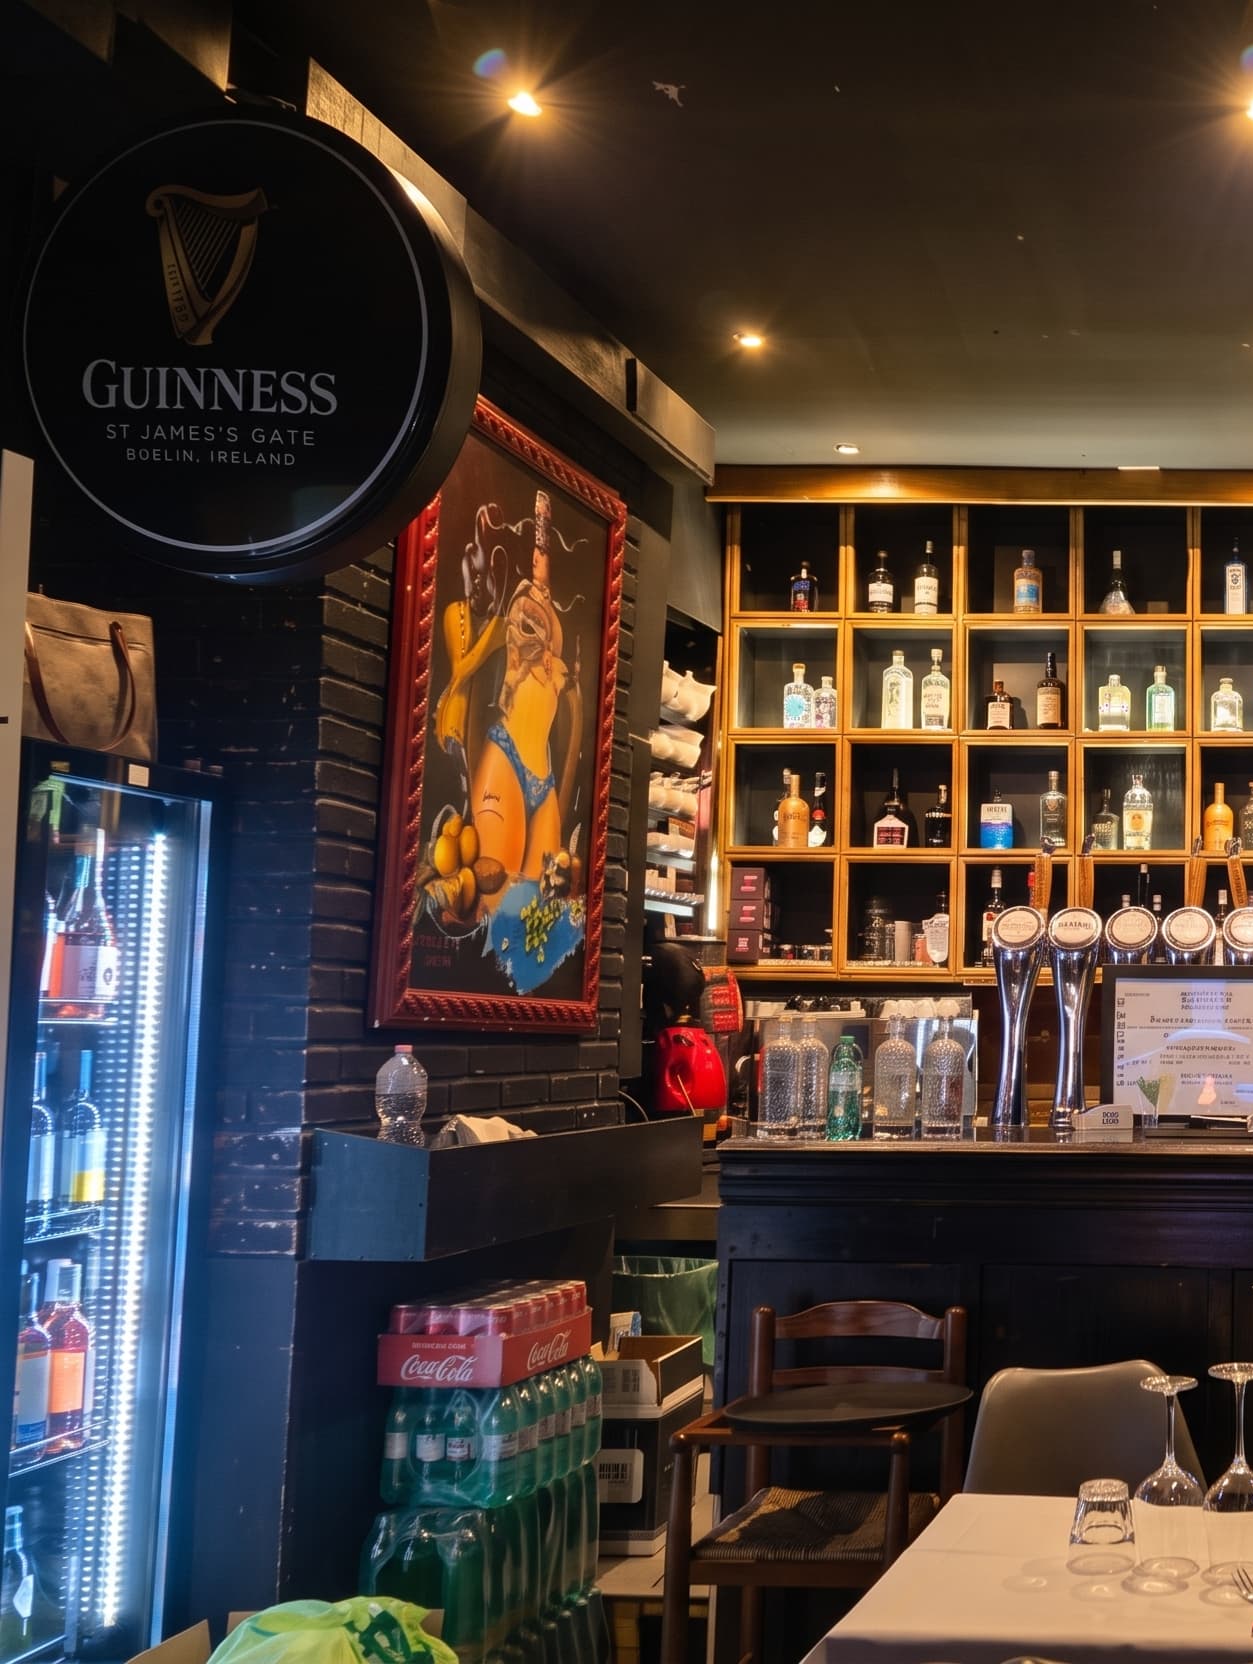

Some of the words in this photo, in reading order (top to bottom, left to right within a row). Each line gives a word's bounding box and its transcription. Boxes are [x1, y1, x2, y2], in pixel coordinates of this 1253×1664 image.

[82, 358, 338, 416] GUINNESS
[106, 424, 131, 439] ST
[140, 424, 240, 443] JAMES'S
[251, 428, 316, 446] GATE
[210, 450, 296, 466] IRELAND
